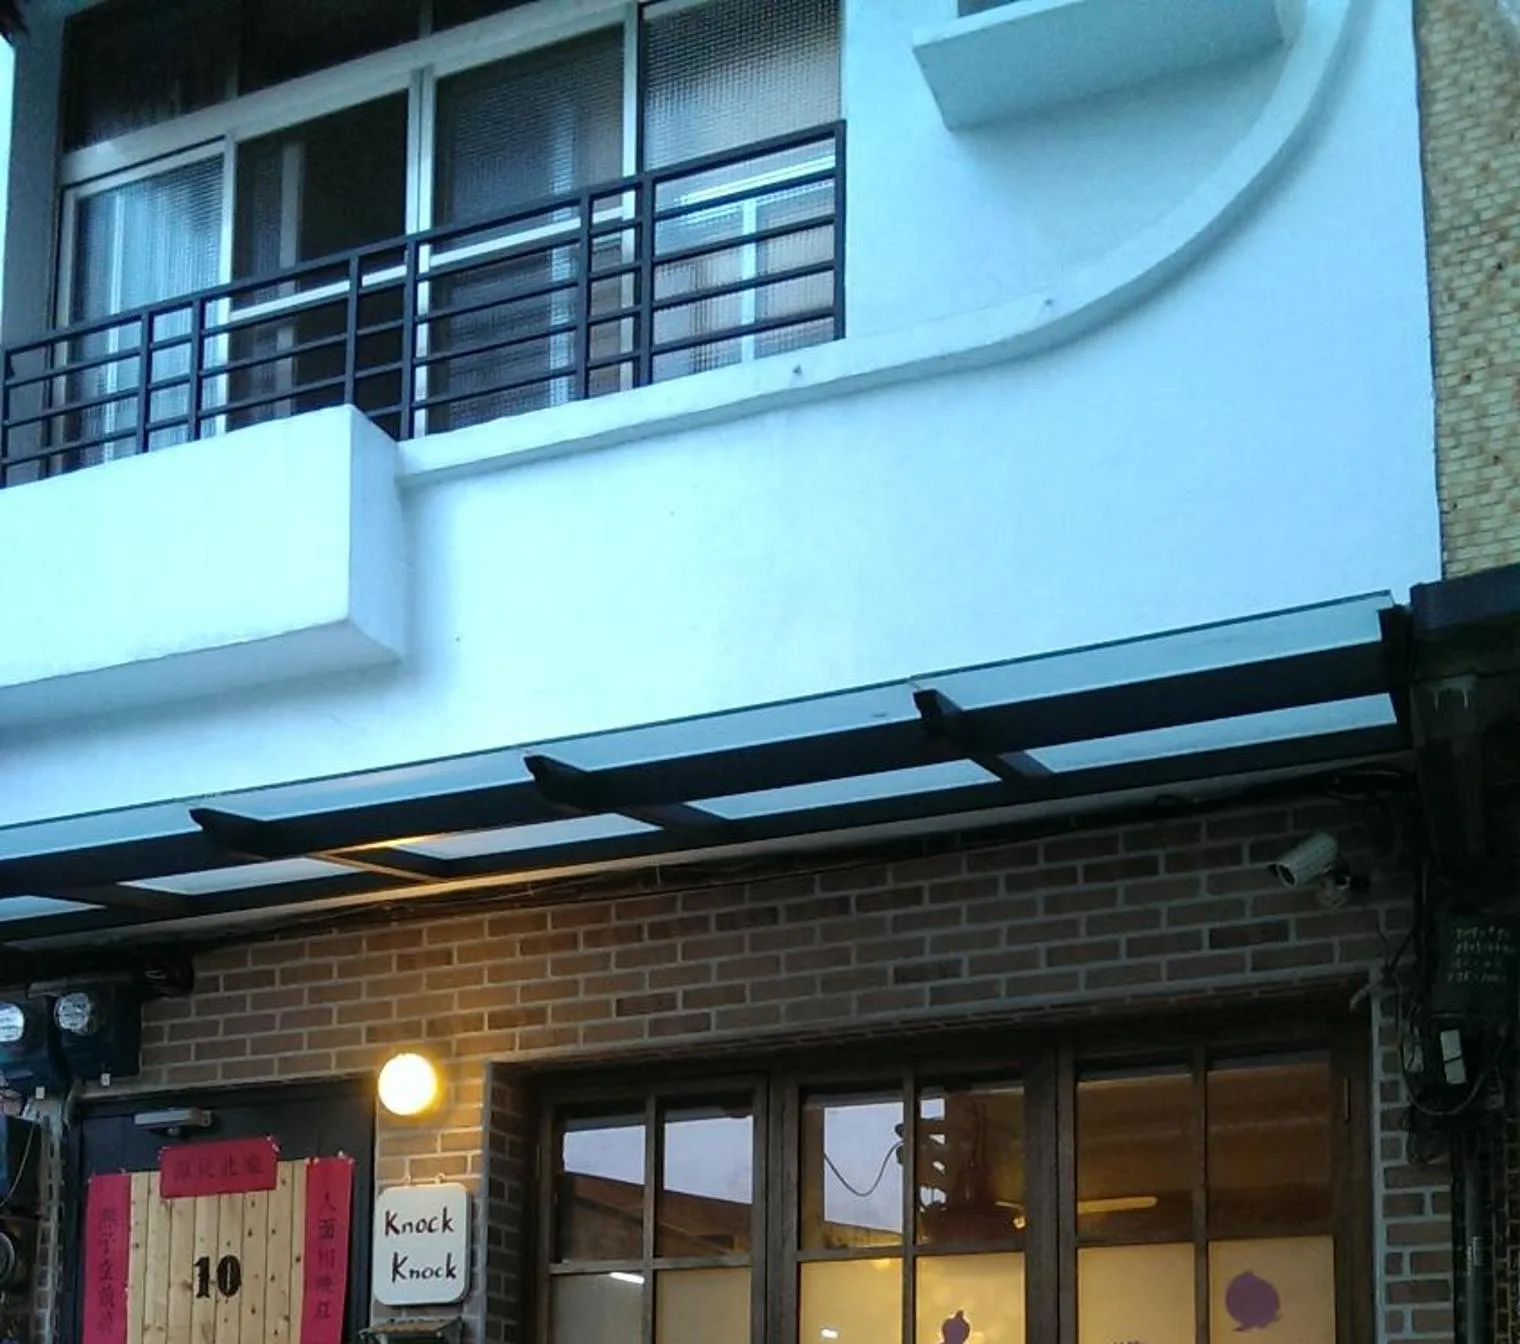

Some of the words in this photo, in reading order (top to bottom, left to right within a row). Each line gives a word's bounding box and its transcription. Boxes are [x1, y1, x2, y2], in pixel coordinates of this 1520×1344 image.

[385, 1205, 455, 1237] Knock
[194, 1255, 241, 1298] 10
[392, 1251, 457, 1284] Knock
